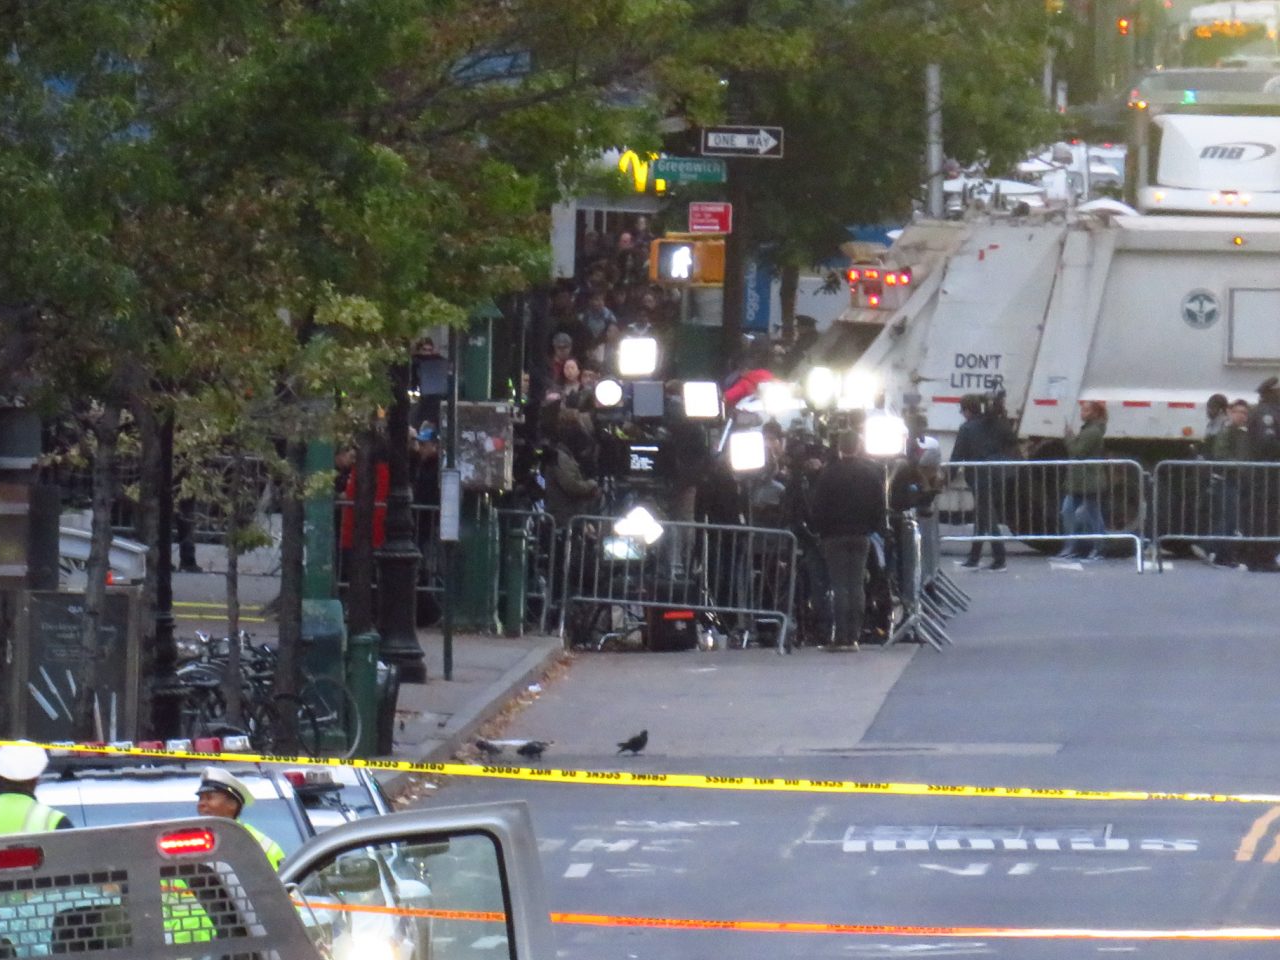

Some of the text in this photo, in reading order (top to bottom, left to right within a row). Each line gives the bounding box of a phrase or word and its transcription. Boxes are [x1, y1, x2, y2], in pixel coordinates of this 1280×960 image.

[713, 135, 771, 147] ONE WAY
[658, 160, 721, 174] Greenwich
[955, 353, 1002, 369] DON'T
[951, 373, 1004, 390] LITTER
